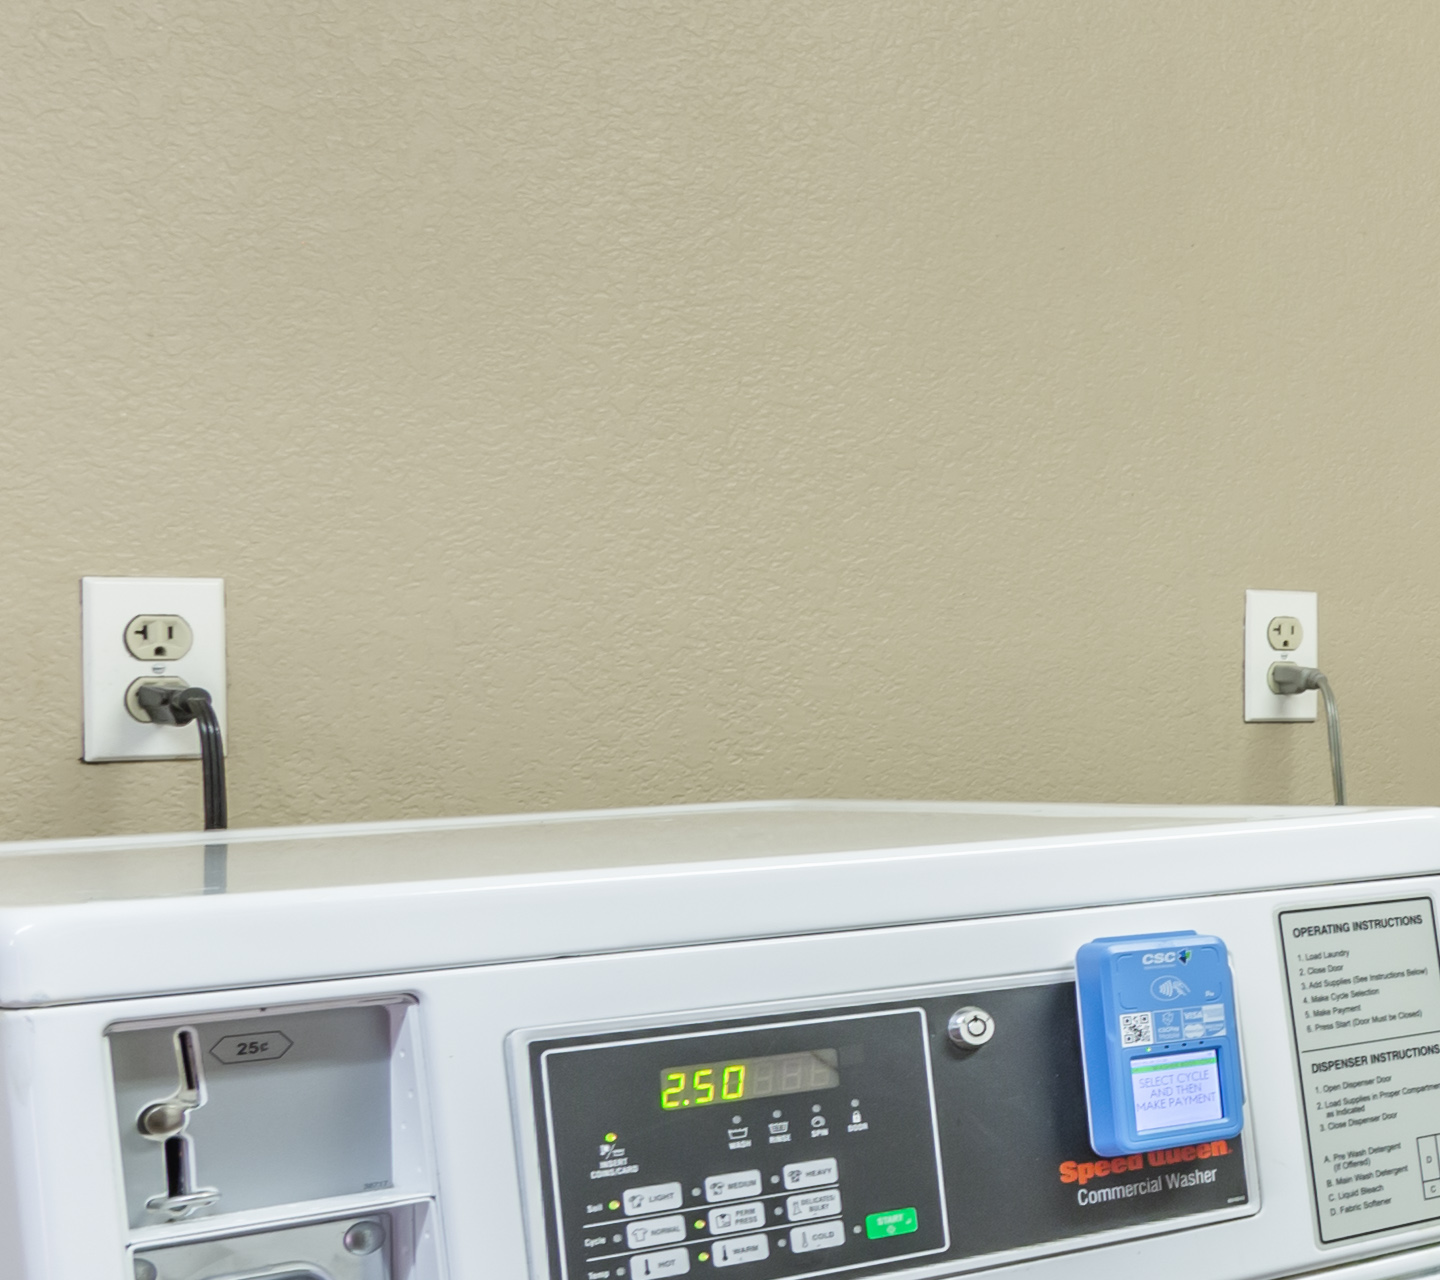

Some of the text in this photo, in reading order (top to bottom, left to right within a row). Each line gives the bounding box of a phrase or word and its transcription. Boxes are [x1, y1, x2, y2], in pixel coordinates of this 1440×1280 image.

[1293, 914, 1423, 938] OPERATING INSTRUCTIONS
[1142, 951, 1176, 966] CSC
[1305, 949, 1350, 961] Load Laundry
[1307, 964, 1344, 975] Close Door
[1309, 967, 1428, 989] Add Supplies (See Instructions Below)
[1311, 987, 1380, 1003] Make Cycle Selection
[1313, 1004, 1361, 1018] Make Payment
[1315, 1009, 1422, 1032] Press Start (Door Must be Closed)
[1311, 1044, 1440, 1074] DISPENSER INSTRUCTIONS
[661, 1064, 746, 1110] 2.50
[1139, 1069, 1209, 1089] SELECT CYCLE
[1323, 1075, 1392, 1094] Open Dispenser Door
[1150, 1082, 1202, 1098] AND THEN
[1136, 1091, 1216, 1112] MAKE PAYMENT
[1324, 1099, 1342, 1109] Load
[1343, 1095, 1371, 1107] Supplies
[1379, 1089, 1401, 1101] Proper
[1336, 1105, 1365, 1116] Indicated
[1327, 1112, 1398, 1131] Close Dispenser Door
[1333, 1142, 1401, 1161] Pre Wash Detergent
[805, 1167, 832, 1178] HEAVY
[1059, 1153, 1144, 1185] Speed
[1342, 1157, 1371, 1171] Offered)
[1335, 1165, 1408, 1186] Main Wash Detergent
[1077, 1167, 1217, 1206] Commercial Washer
[1338, 1184, 1384, 1201] Liquid Bleach
[1430, 1185, 1437, 1193] C
[649, 1192, 675, 1203] LIGHT
[1339, 1197, 1392, 1214] Fabric Softener
[650, 1225, 680, 1236] NORMAL
[812, 1231, 834, 1242] COLD
[732, 1244, 759, 1255] WARM
[657, 1258, 676, 1268] HOT
